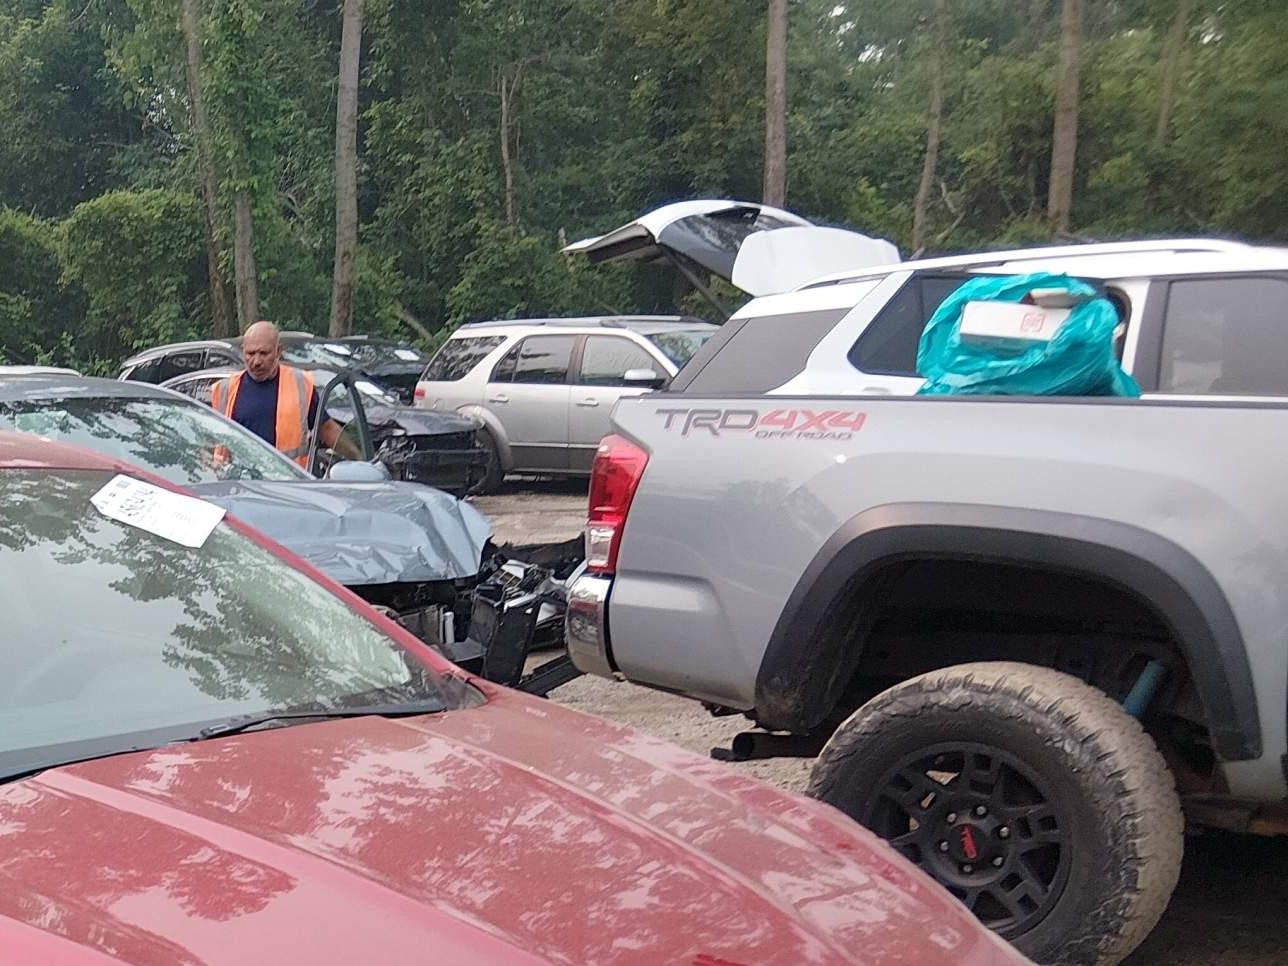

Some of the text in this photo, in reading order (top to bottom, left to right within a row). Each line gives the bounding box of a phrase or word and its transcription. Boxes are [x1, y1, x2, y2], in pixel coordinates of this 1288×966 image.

[655, 408, 868, 436] TRD 4X4
[755, 431, 853, 440] OFF ROAD
